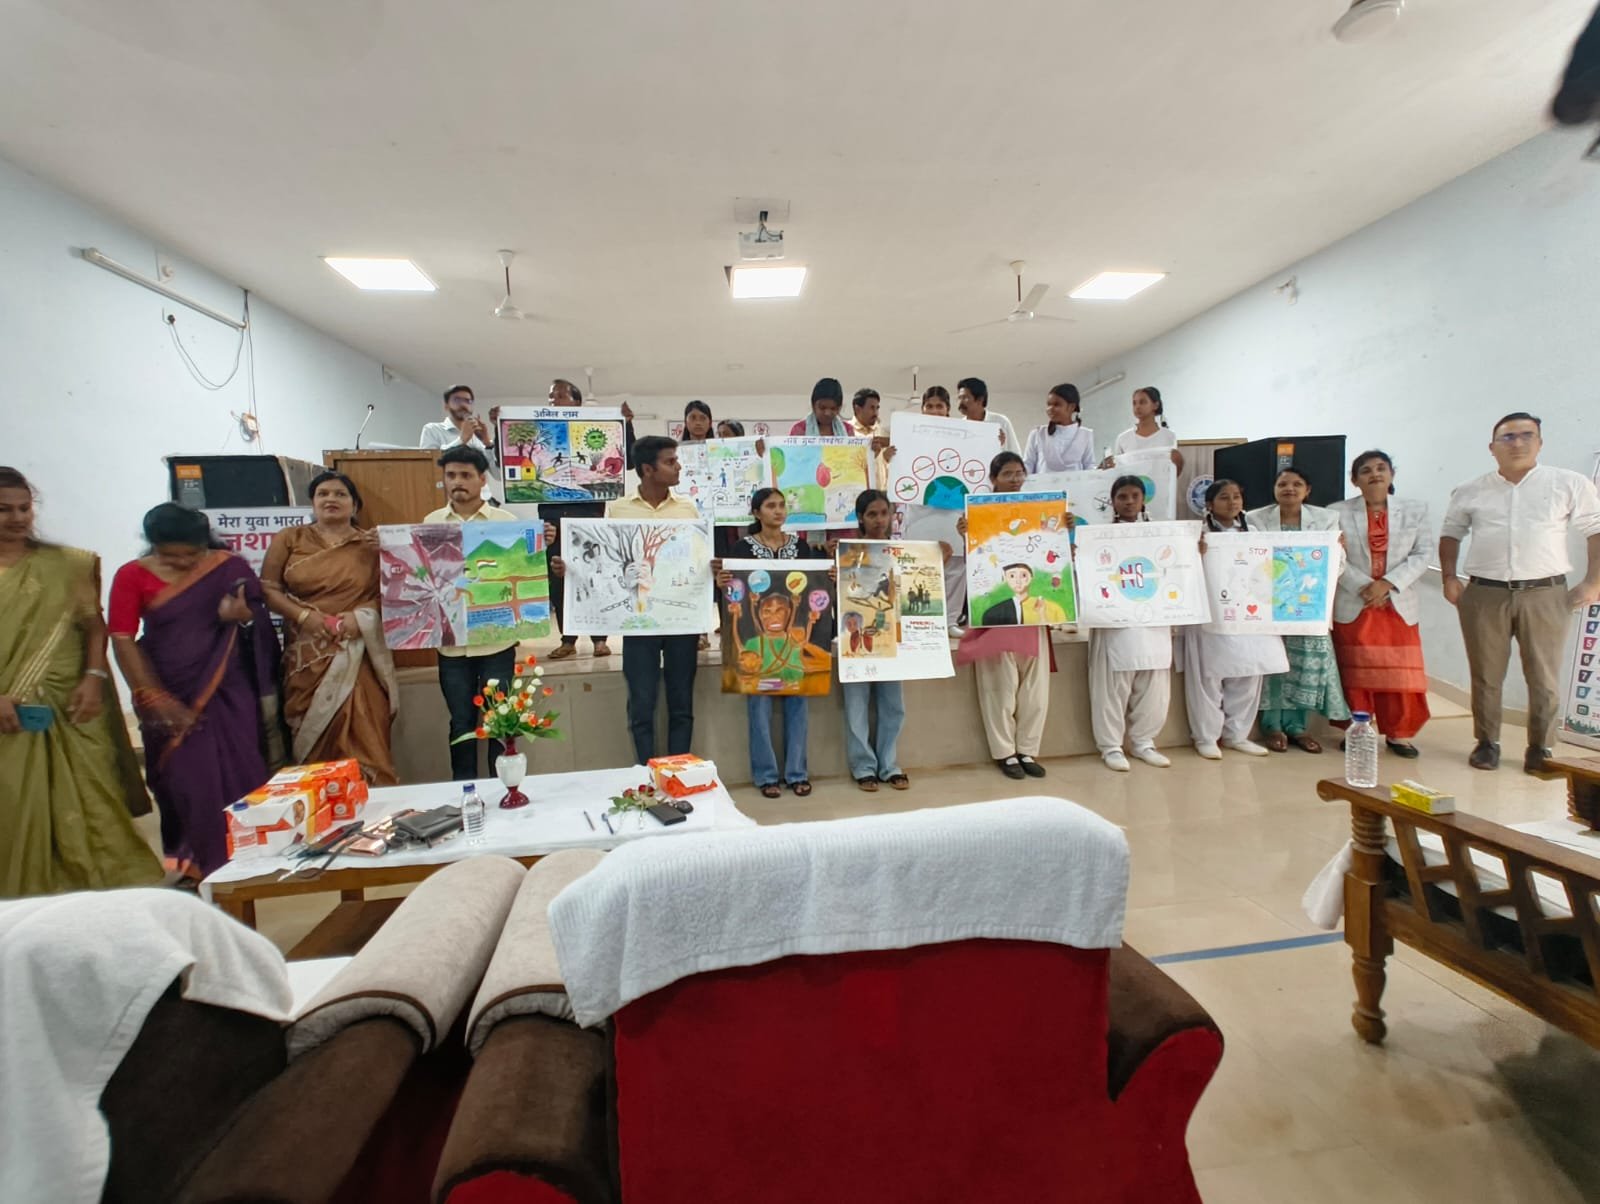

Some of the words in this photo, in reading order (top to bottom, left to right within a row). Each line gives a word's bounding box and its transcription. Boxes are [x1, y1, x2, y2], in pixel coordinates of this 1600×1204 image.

[533, 408, 559, 418] अनिल
[562, 410, 579, 418] राम
[217, 513, 242, 528] मेरा
[244, 515, 271, 531] युवा
[273, 515, 304, 527] भारत
[1248, 547, 1268, 556] STOP
